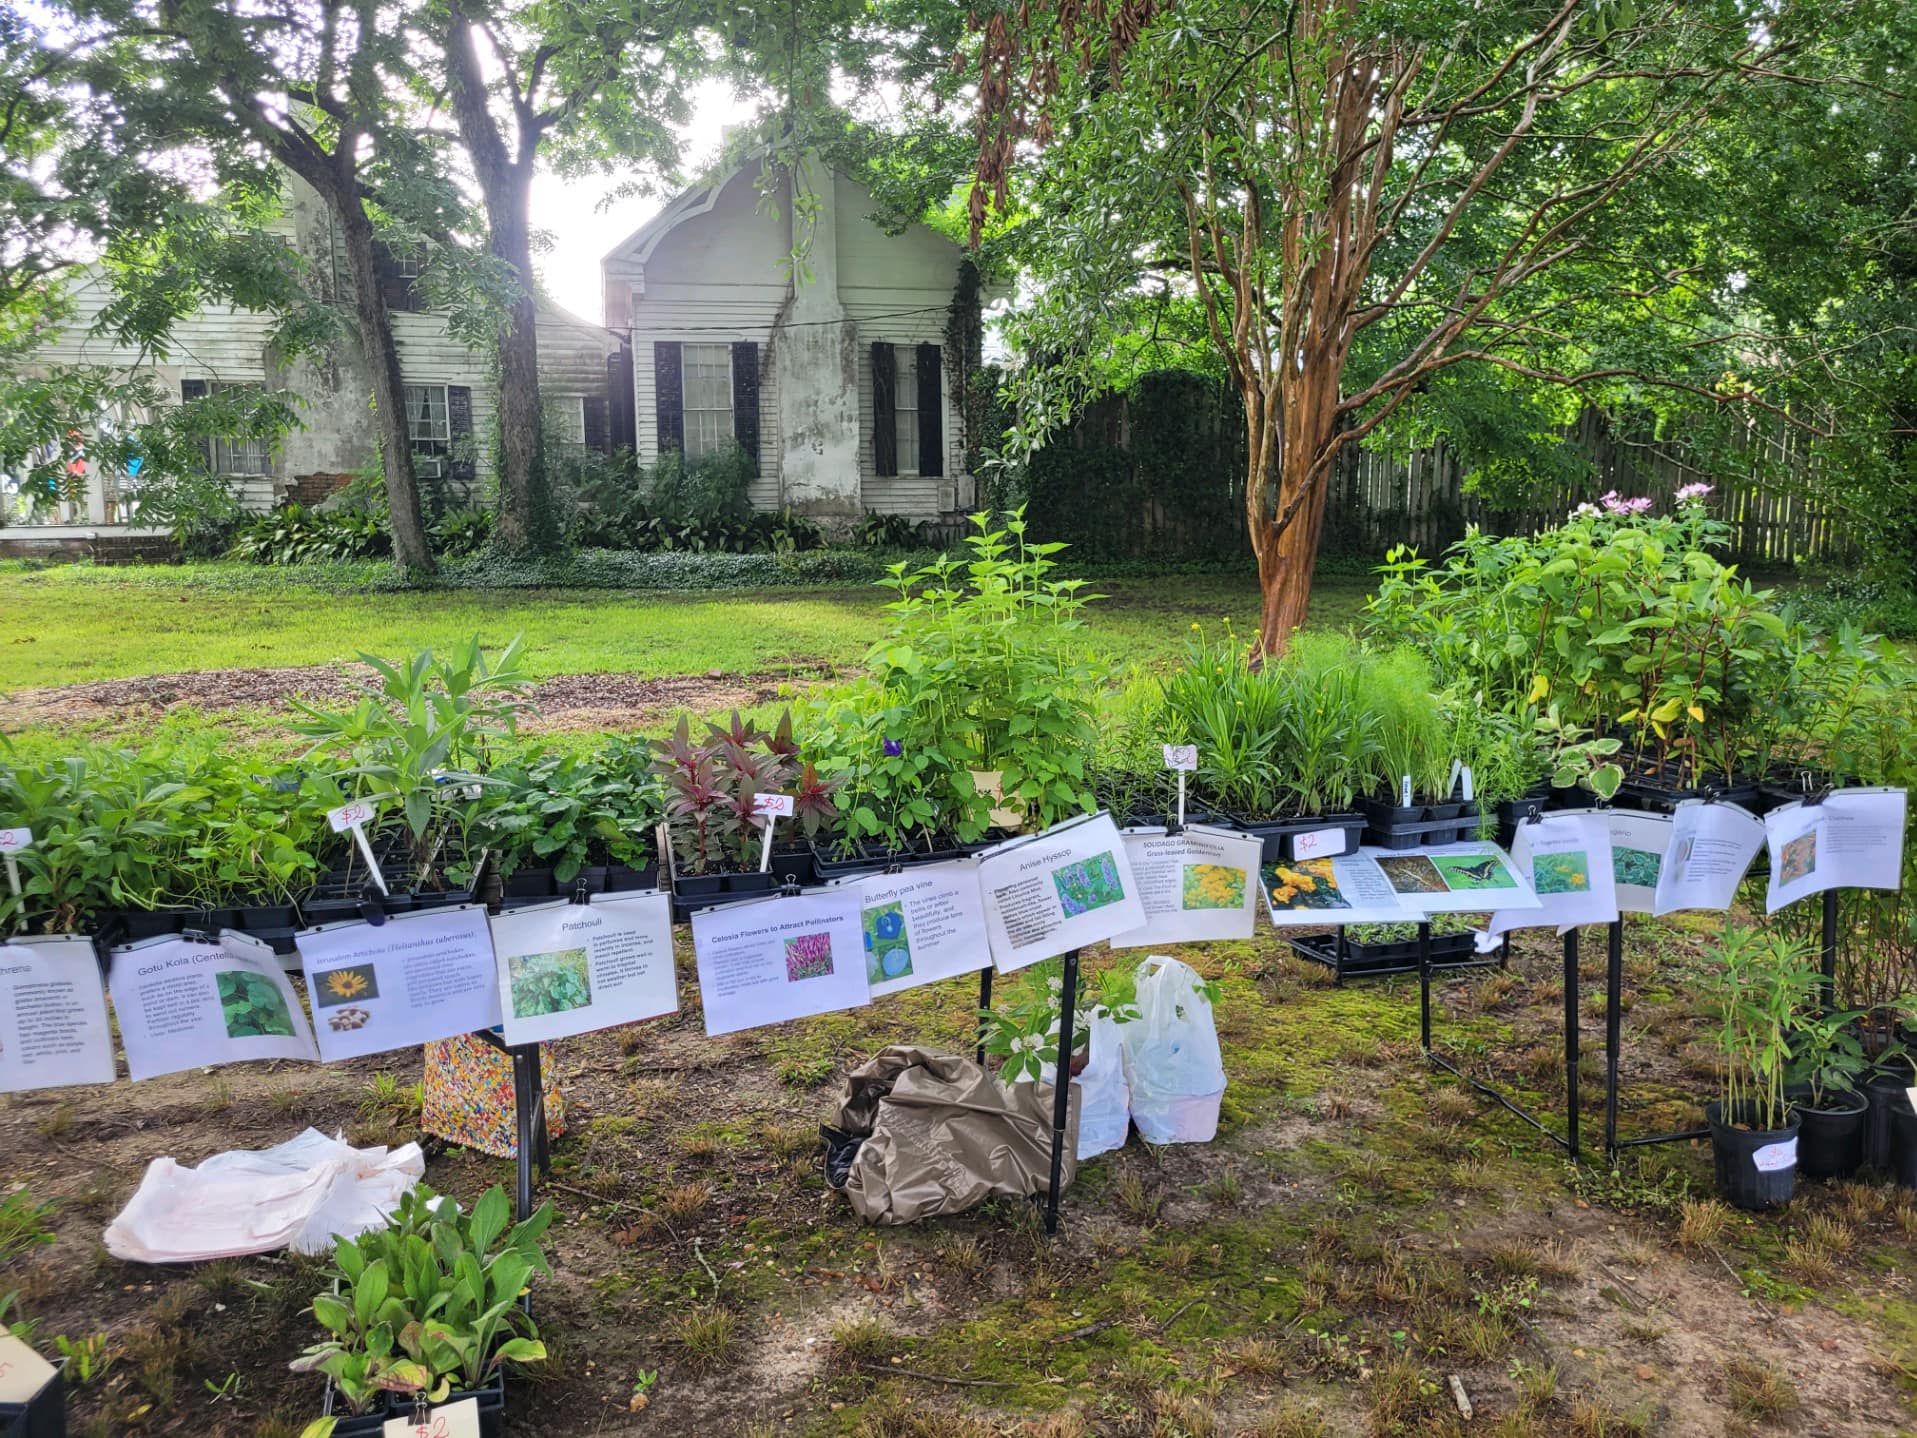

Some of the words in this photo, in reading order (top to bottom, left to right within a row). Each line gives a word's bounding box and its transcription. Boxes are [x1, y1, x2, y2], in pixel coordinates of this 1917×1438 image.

[764, 796, 784, 811] $2
[342, 804, 364, 825] $2
[0, 831, 18, 846] 2
[1144, 840, 1175, 849] SOLIDAGO
[1299, 833, 1318, 851] $2
[1020, 860, 1041, 871] Anise
[1043, 848, 1072, 864] Hyssop
[864, 889, 898, 904] Butterfly
[899, 885, 915, 896] pea
[916, 880, 933, 889] vine
[562, 917, 602, 932] Patchouli
[712, 933, 739, 943] Celosia
[740, 927, 769, 938] Flowers
[770, 925, 778, 933] to
[779, 921, 804, 931] Attract
[805, 915, 844, 927] Pollinators
[317, 953, 352, 965] Jerusalem
[354, 947, 386, 959] Artichoke
[138, 963, 163, 976] Gotu
[166, 958, 189, 969] Kola
